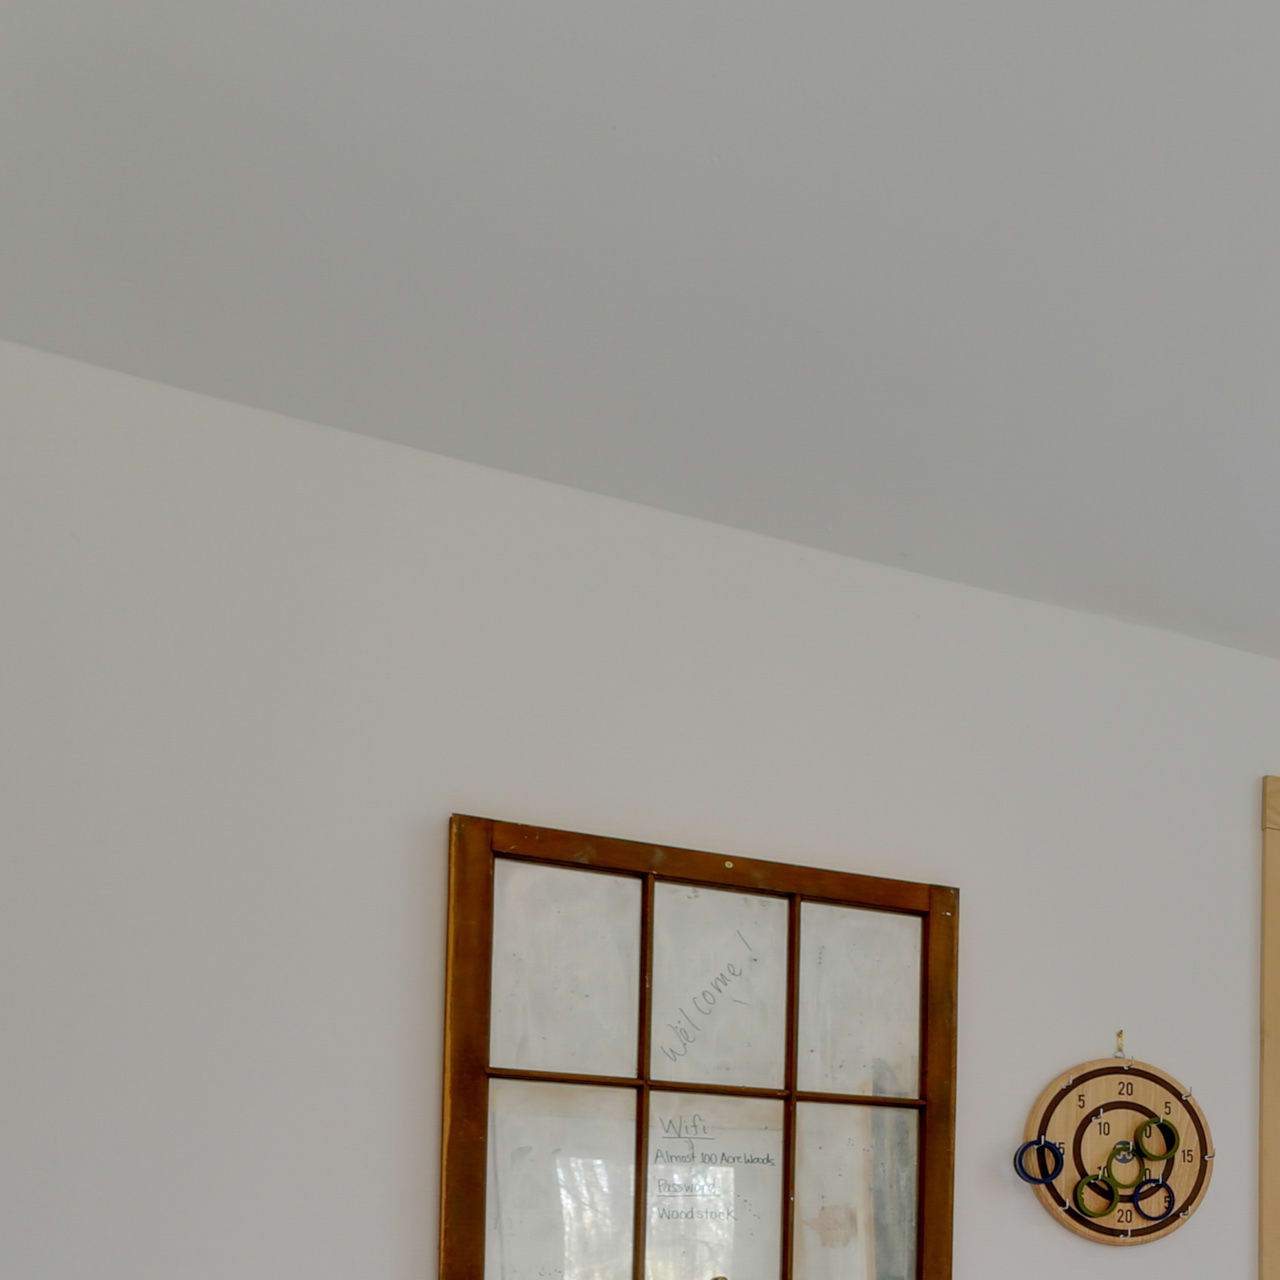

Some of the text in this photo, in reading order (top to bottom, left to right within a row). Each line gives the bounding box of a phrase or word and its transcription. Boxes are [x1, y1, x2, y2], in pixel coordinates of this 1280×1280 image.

[1118, 1082, 1133, 1096] 20
[1078, 1095, 1085, 1108] 5
[1164, 1102, 1171, 1115] 5
[659, 1113, 709, 1138] Wifi
[1098, 1122, 1110, 1135] 10
[654, 1148, 697, 1166] Almost
[1182, 1150, 1193, 1163] 15
[657, 1178, 717, 1195] Password
[657, 1207, 738, 1222] Woodstock
[1117, 1209, 1132, 1223] 20
